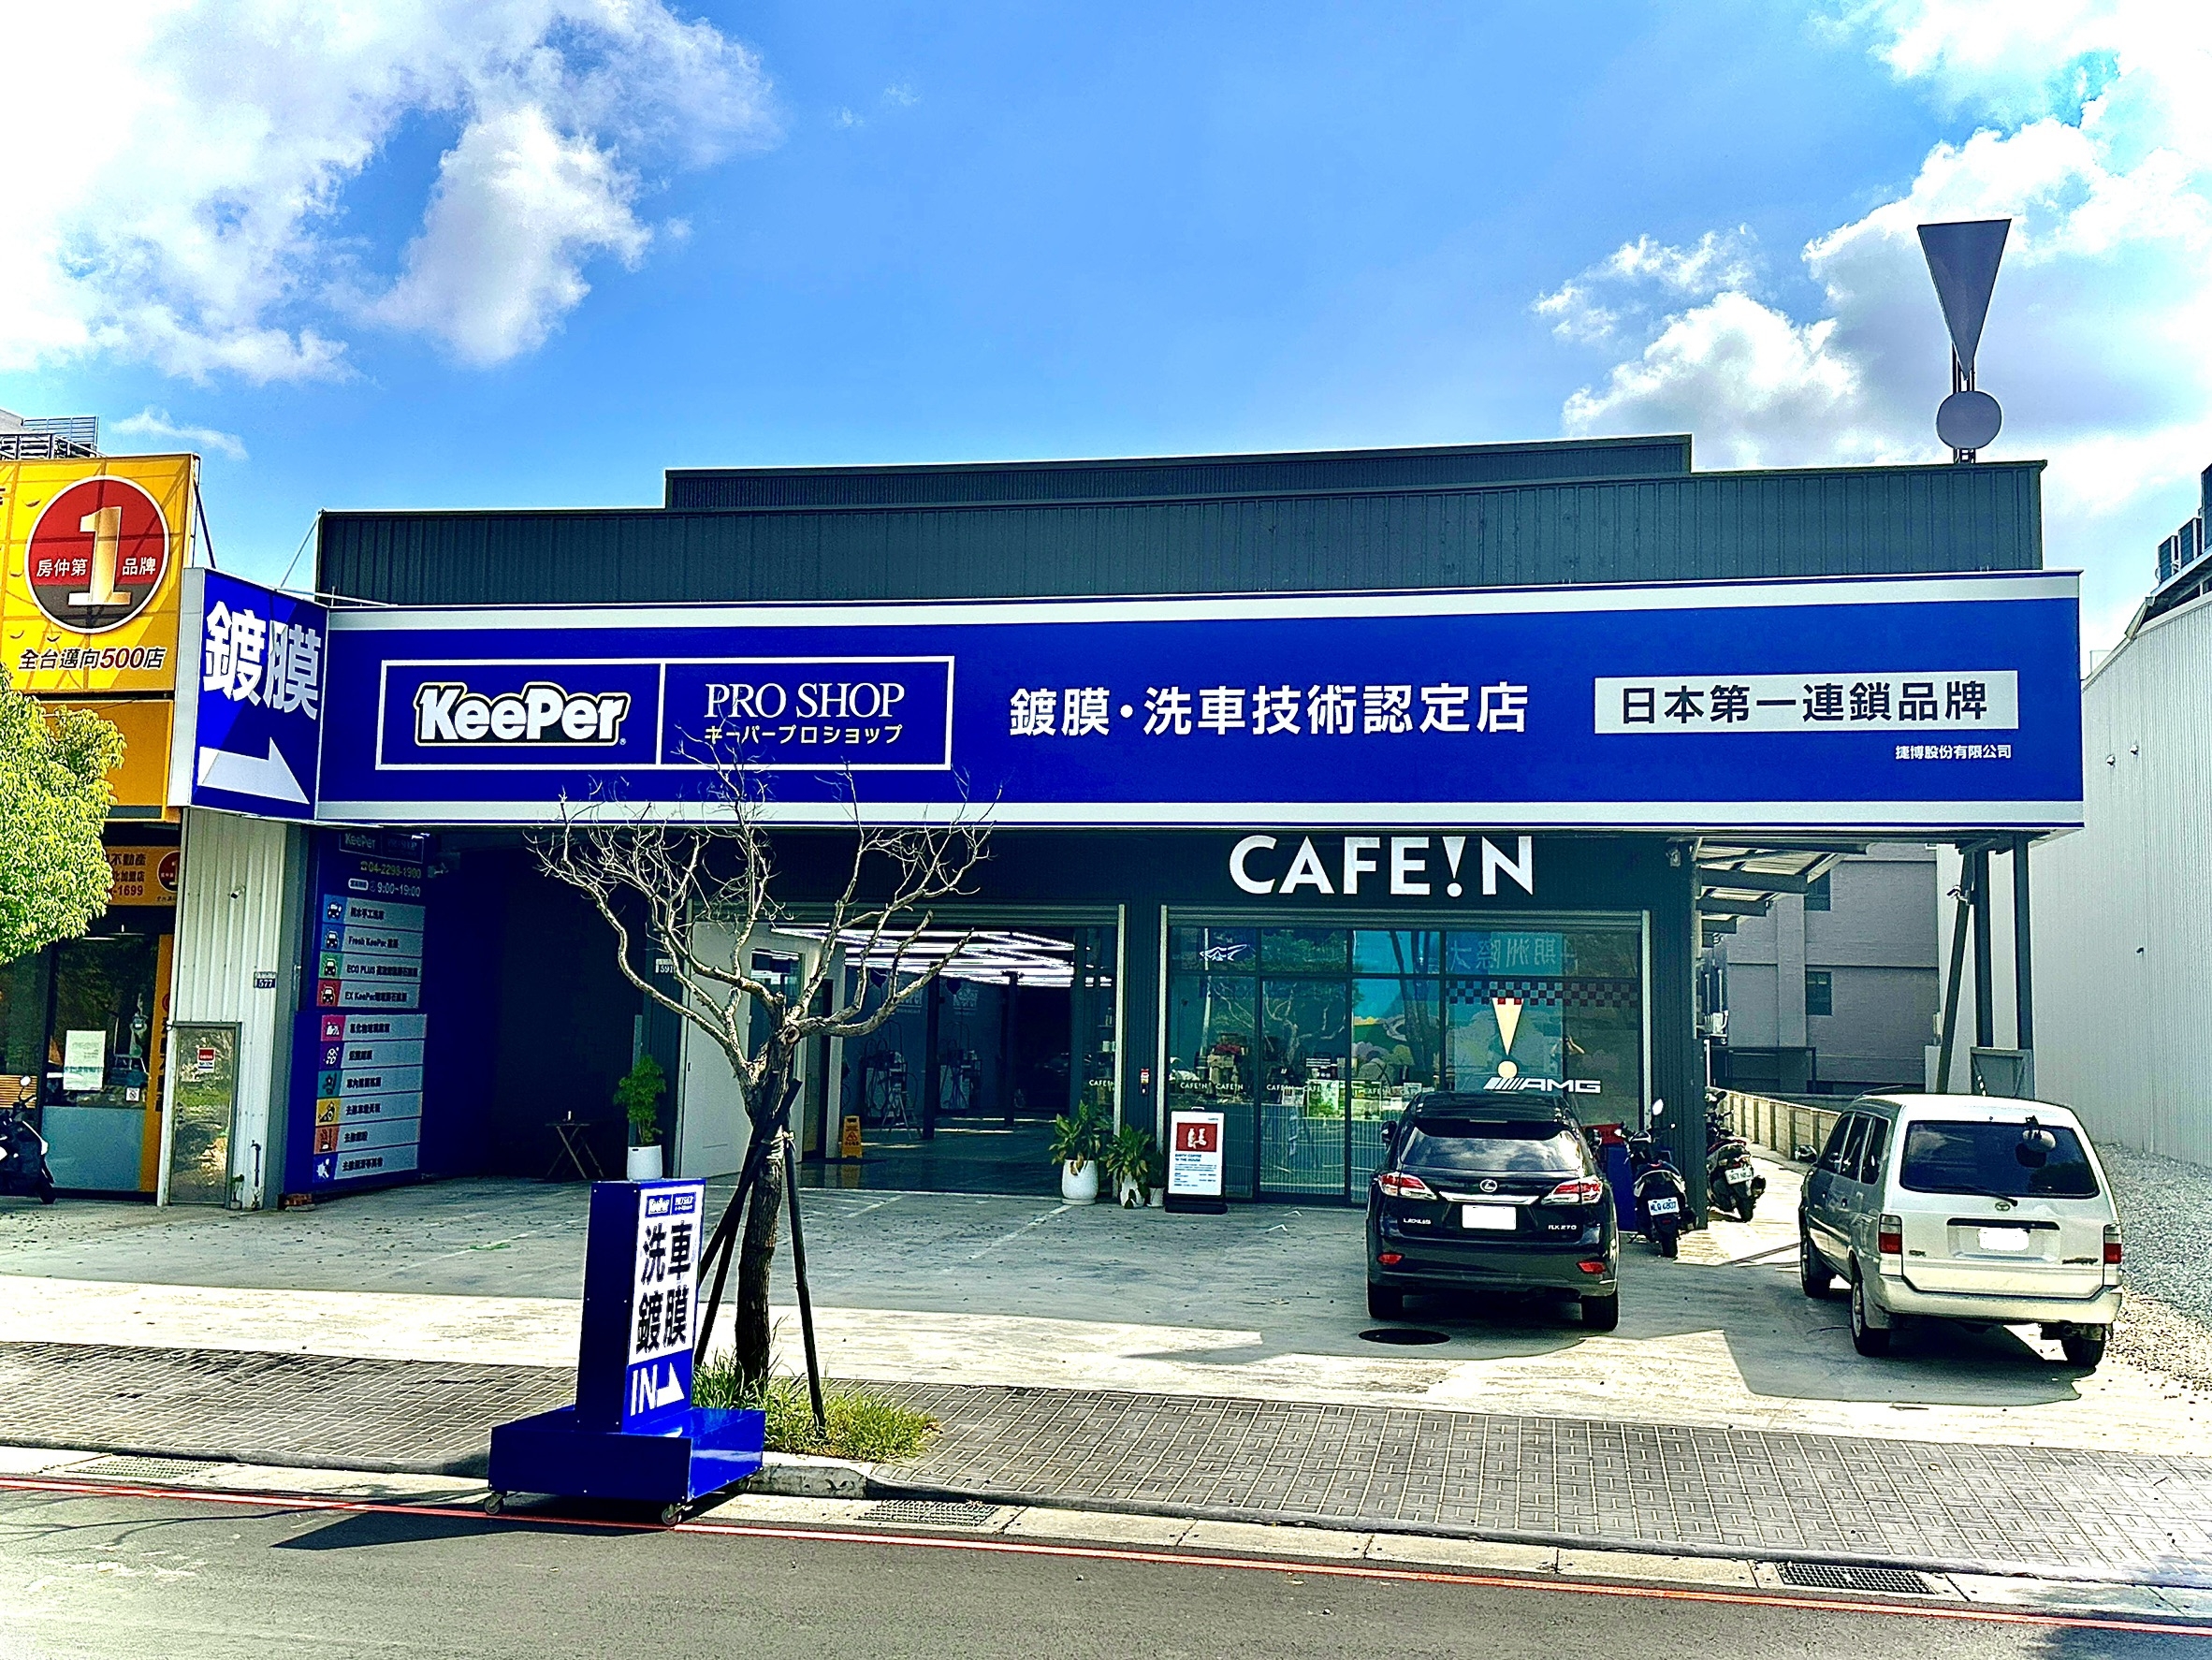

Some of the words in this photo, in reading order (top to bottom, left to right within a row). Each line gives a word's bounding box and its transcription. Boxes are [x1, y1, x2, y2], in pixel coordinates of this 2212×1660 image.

[68, 505, 131, 605] 1
[18, 648, 166, 670] 全台邁向500店
[203, 600, 321, 720] 鍍膜
[418, 683, 627, 744] KeePer
[704, 681, 787, 719] PRO
[795, 682, 905, 719] SHOP
[1623, 680, 1987, 724] 日本第一連鎖品牌
[704, 724, 903, 744] キーパープロショップ
[1895, 744, 2012, 760] 捷博股份有限公司
[640, 1219, 692, 1286] 洗車
[635, 1284, 689, 1355] 鍍膜
[630, 1363, 658, 1417] IN
